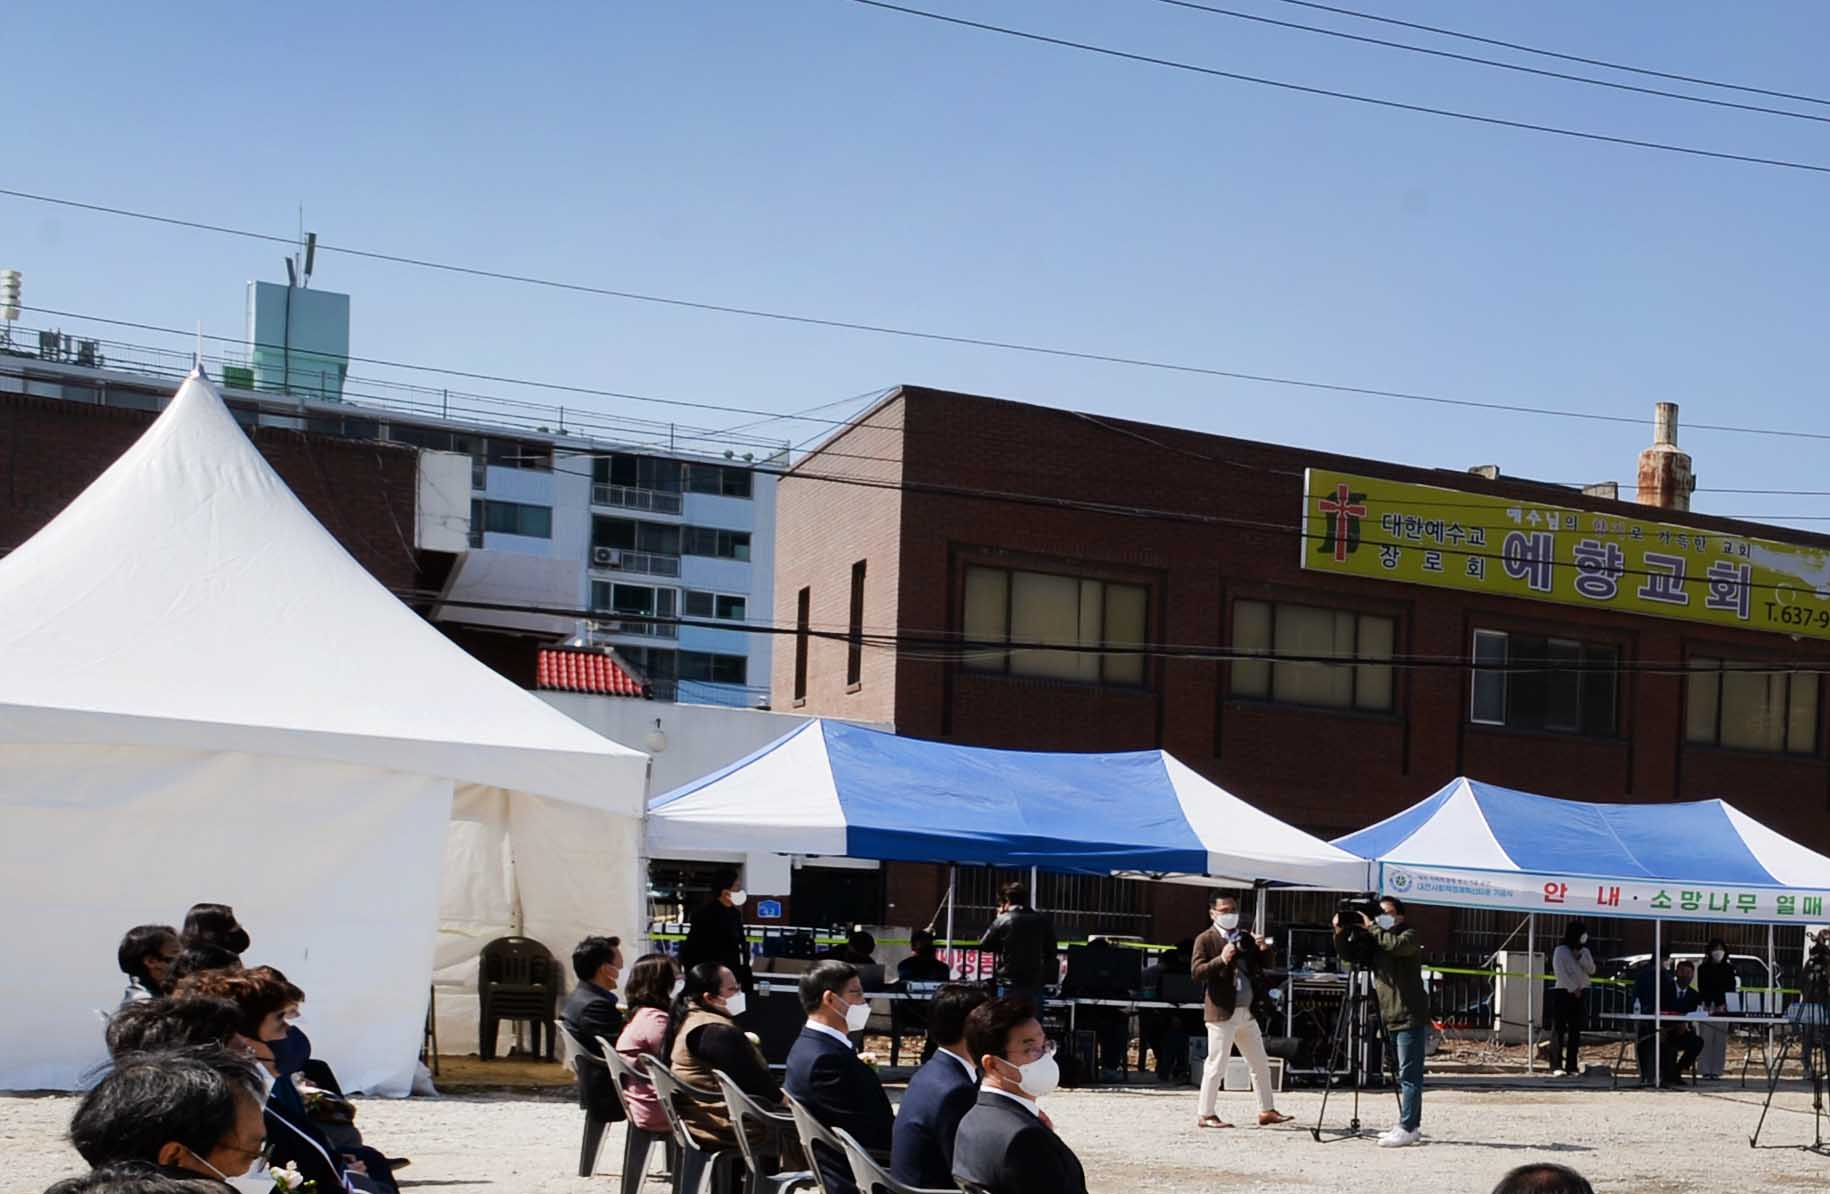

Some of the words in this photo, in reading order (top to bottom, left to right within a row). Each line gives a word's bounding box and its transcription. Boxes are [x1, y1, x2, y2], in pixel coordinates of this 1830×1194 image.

[1382, 513, 1487, 547] 대한예수교
[1502, 530, 1752, 620] 예향교회
[1544, 882, 1621, 907] 안내
[1650, 889, 1758, 913] 소망나무
[1776, 894, 1823, 917] 열매
